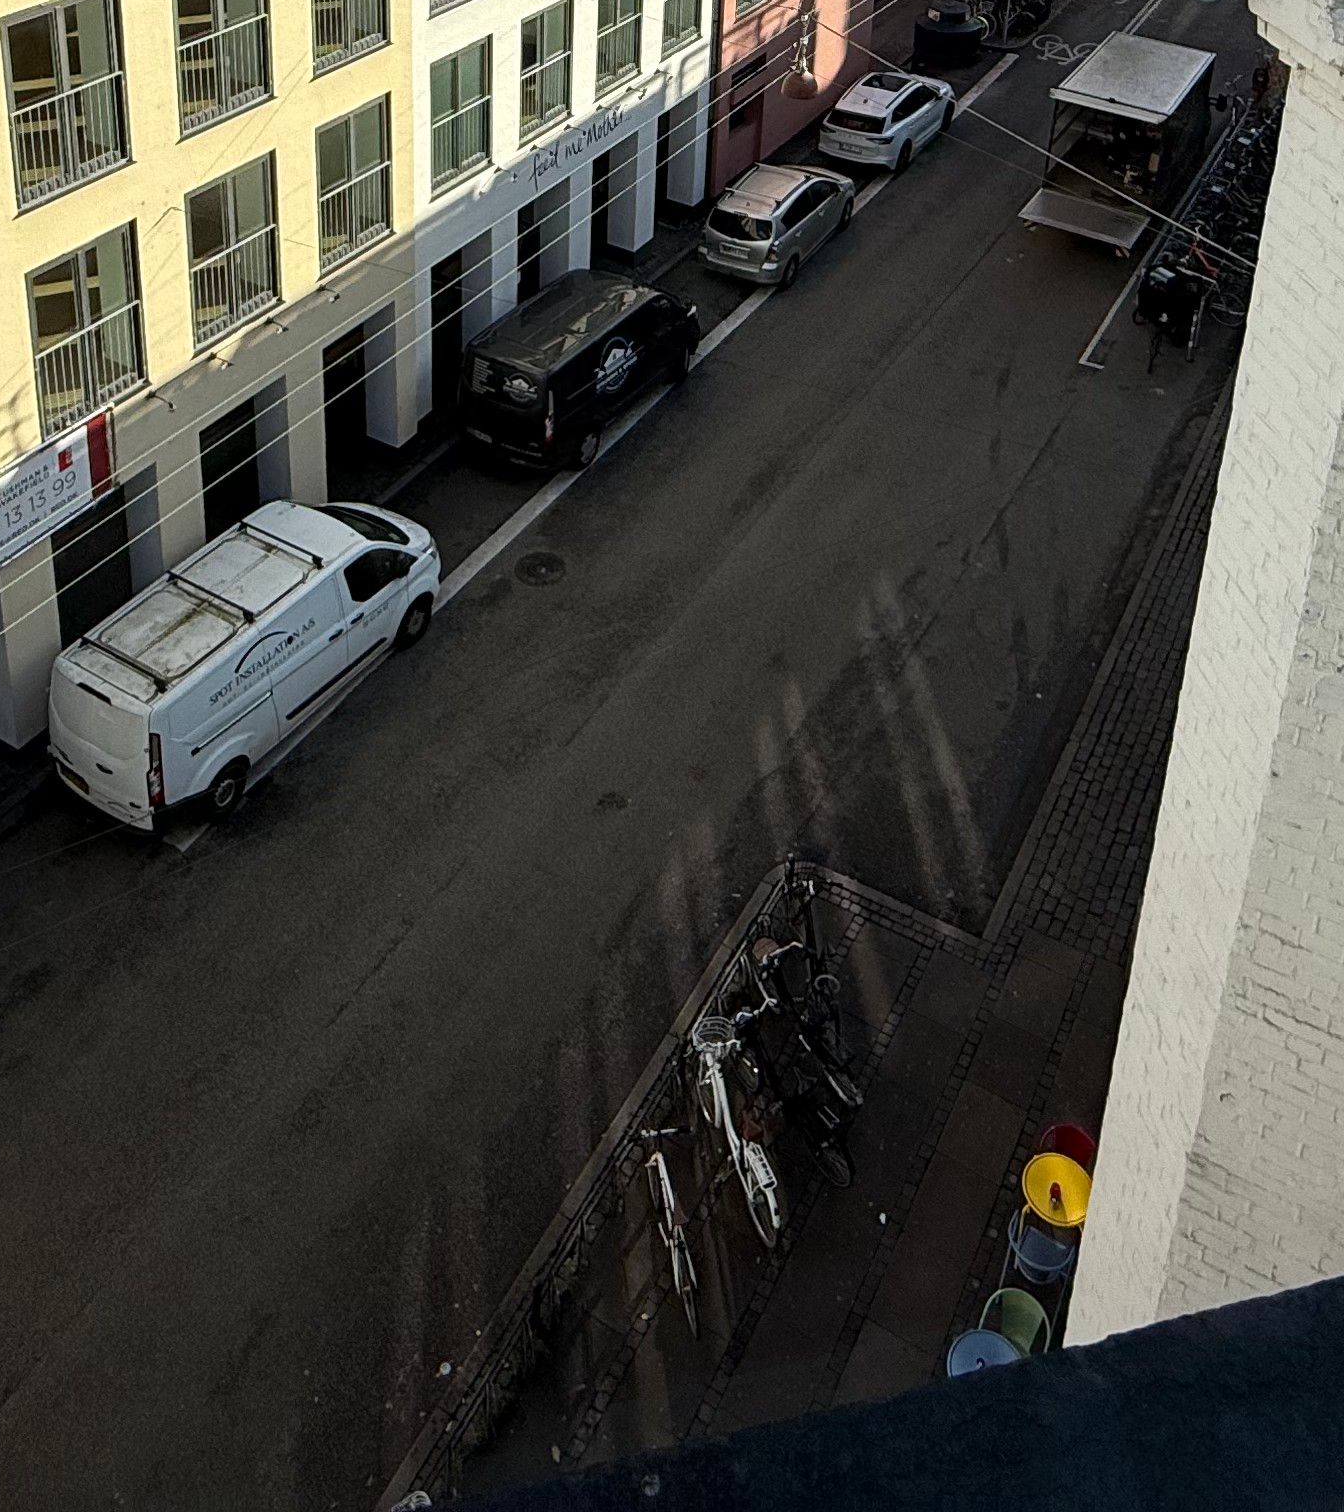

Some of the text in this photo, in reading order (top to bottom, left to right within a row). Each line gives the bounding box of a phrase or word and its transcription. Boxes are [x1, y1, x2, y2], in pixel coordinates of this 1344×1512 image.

[4, 503, 23, 527] 13
[28, 488, 47, 512] 13
[53, 470, 77, 497] 99
[209, 681, 235, 706] SPOT
